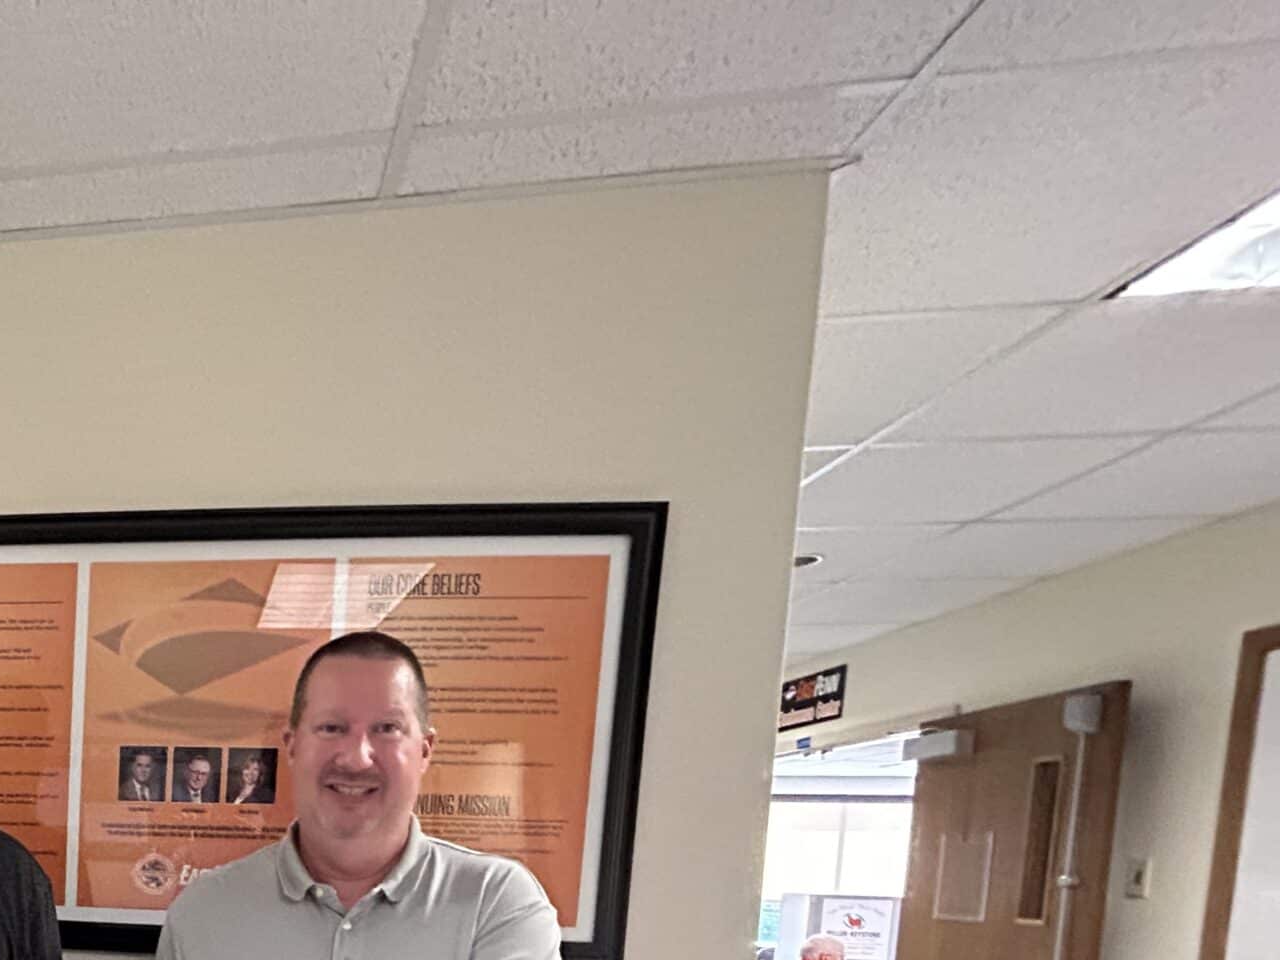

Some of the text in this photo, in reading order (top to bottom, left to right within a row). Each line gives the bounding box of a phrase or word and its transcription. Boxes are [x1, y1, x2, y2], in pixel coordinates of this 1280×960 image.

[431, 573, 481, 596] BELIEFS
[414, 794, 510, 816] NUING MISSION
